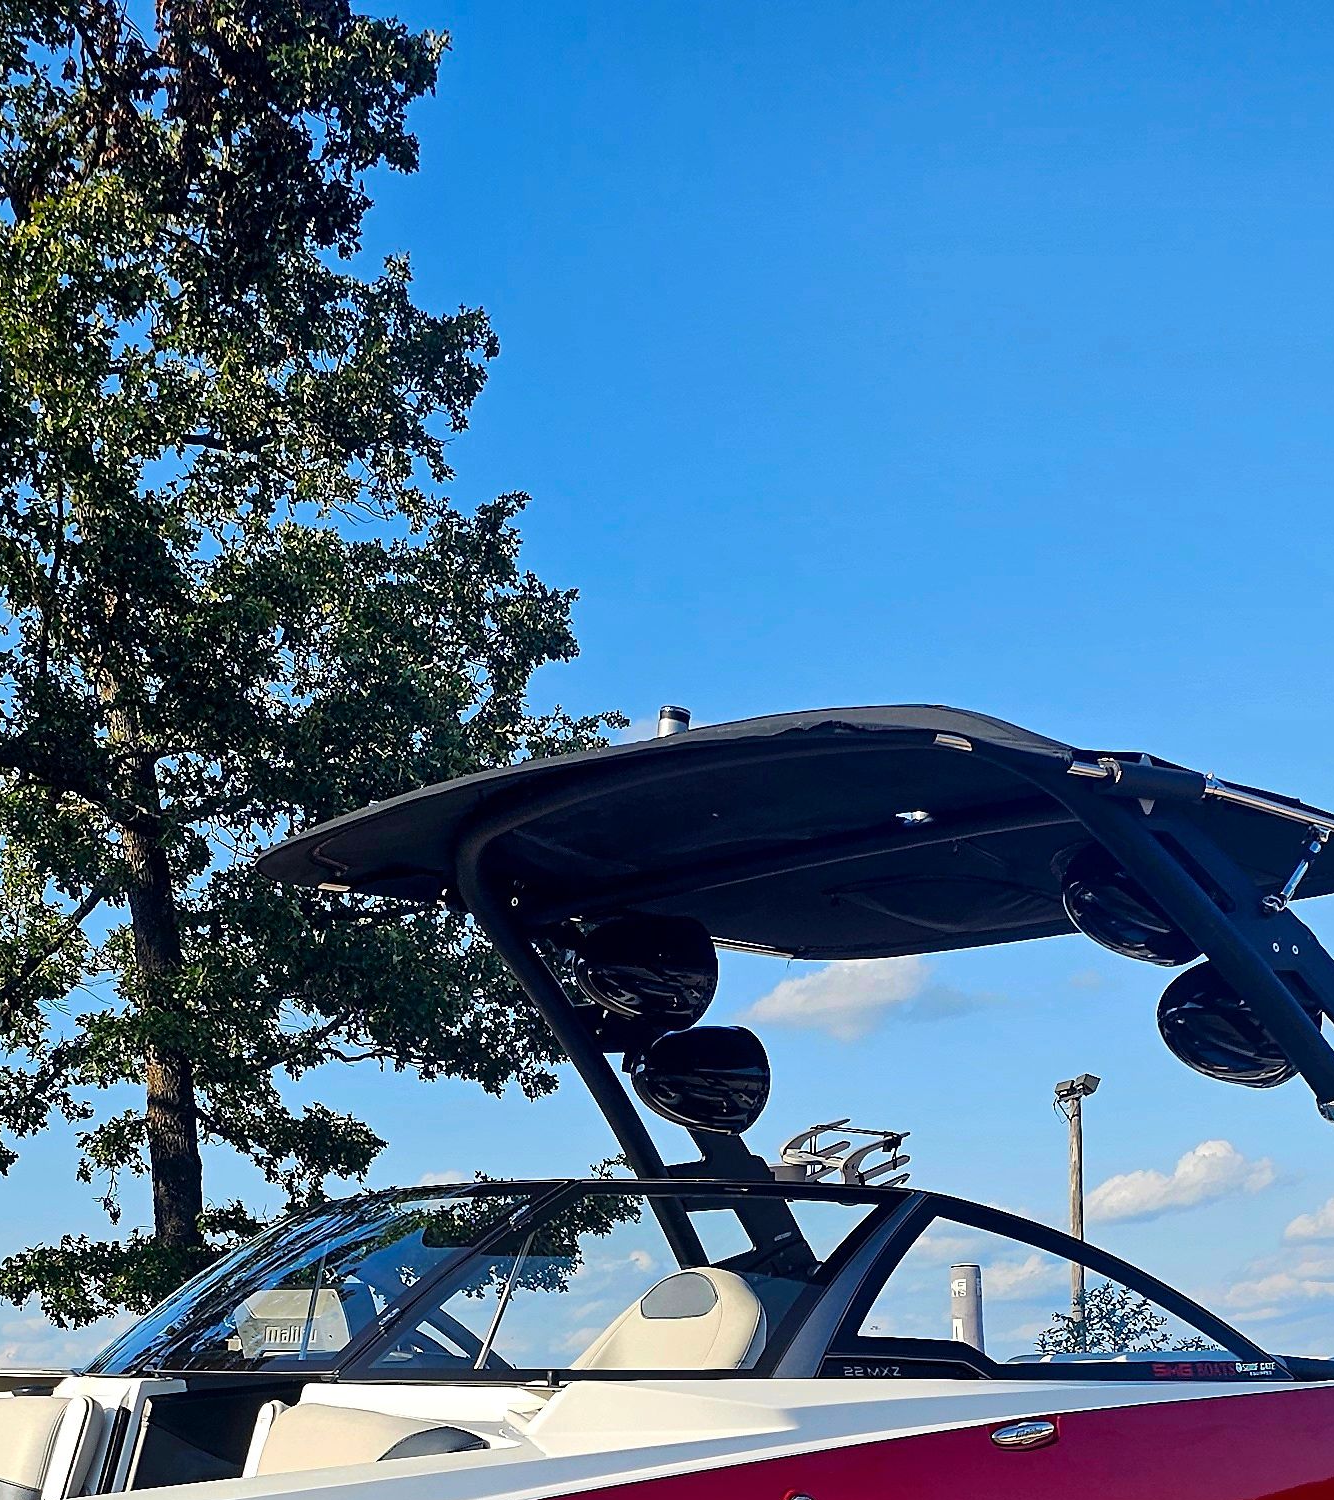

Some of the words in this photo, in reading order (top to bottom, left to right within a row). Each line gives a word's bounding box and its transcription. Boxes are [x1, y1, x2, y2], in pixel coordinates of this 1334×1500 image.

[265, 1326, 318, 1344] Maliu
[843, 1366, 864, 1377] 22
[867, 1366, 901, 1377] MXZ
